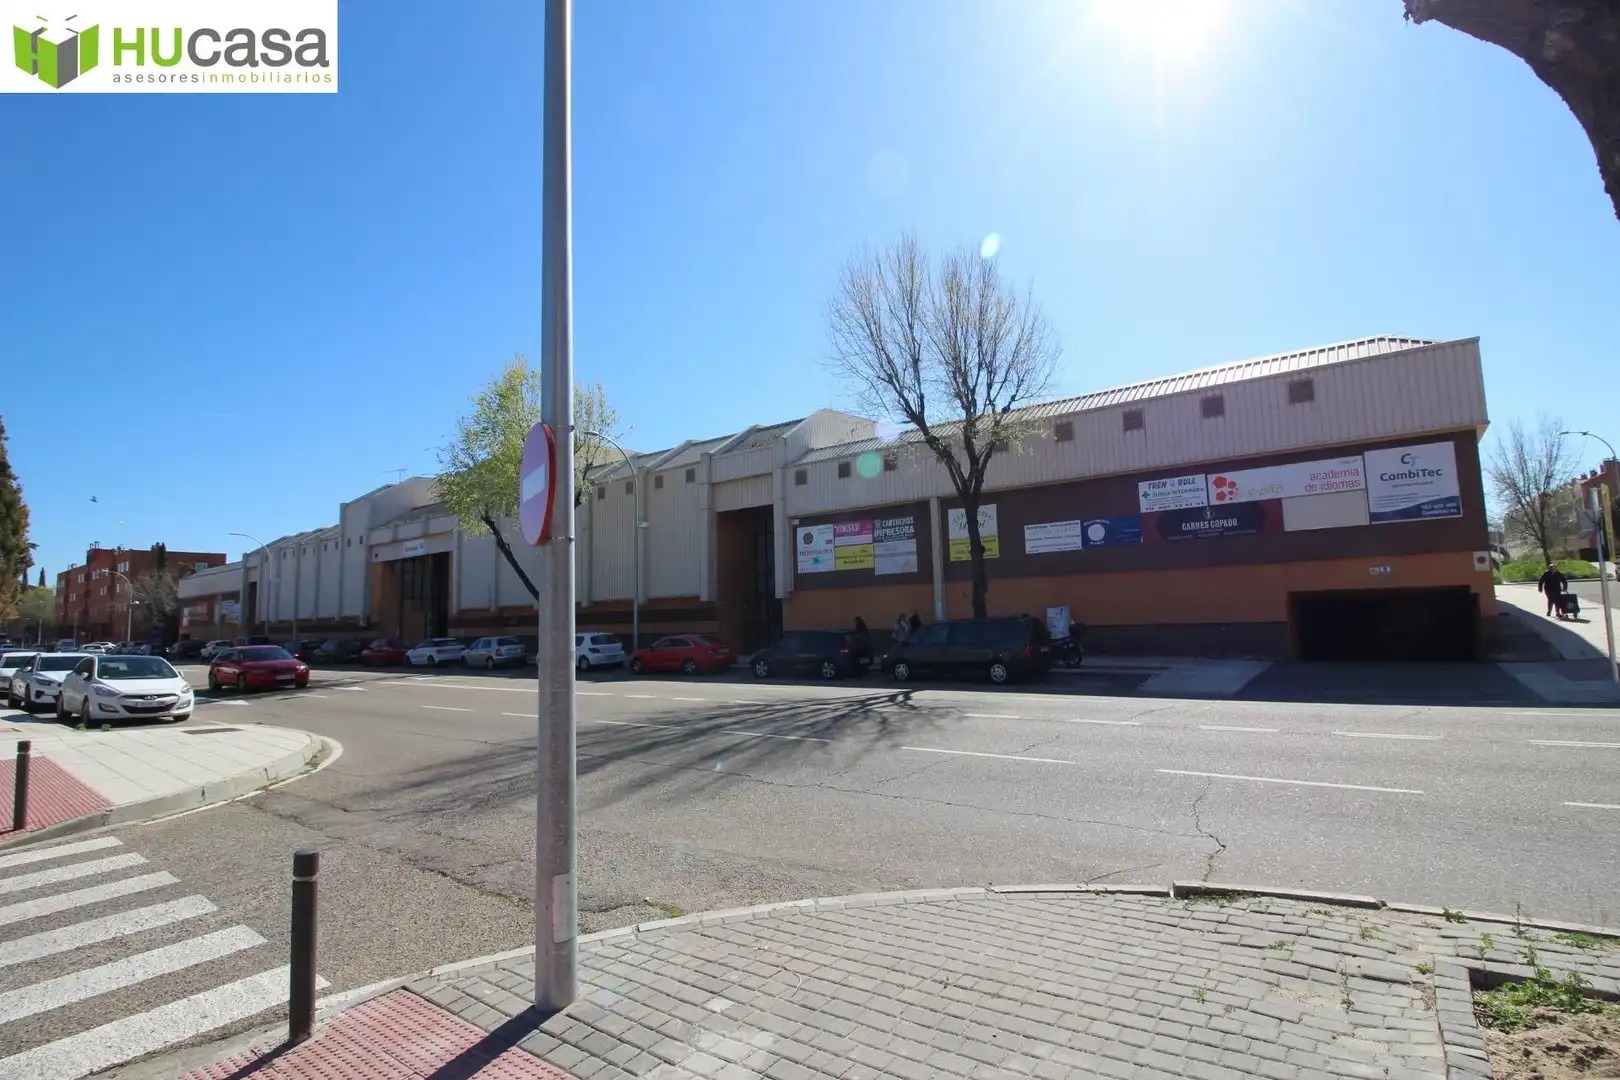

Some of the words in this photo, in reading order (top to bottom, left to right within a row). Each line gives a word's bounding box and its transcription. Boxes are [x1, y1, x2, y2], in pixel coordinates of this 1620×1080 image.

[1310, 467, 1360, 481] academia
[1379, 468, 1443, 482] CombiTec
[1148, 481, 1168, 491] TREN
[1178, 477, 1196, 486] BULL
[1305, 482, 1317, 493] de
[1320, 479, 1360, 491] idiomas
[882, 516, 915, 527] CARTUCHOS
[1182, 521, 1209, 531] CARNES
[1210, 518, 1238, 529] COPADO
[875, 525, 915, 538] IMPRESORA
